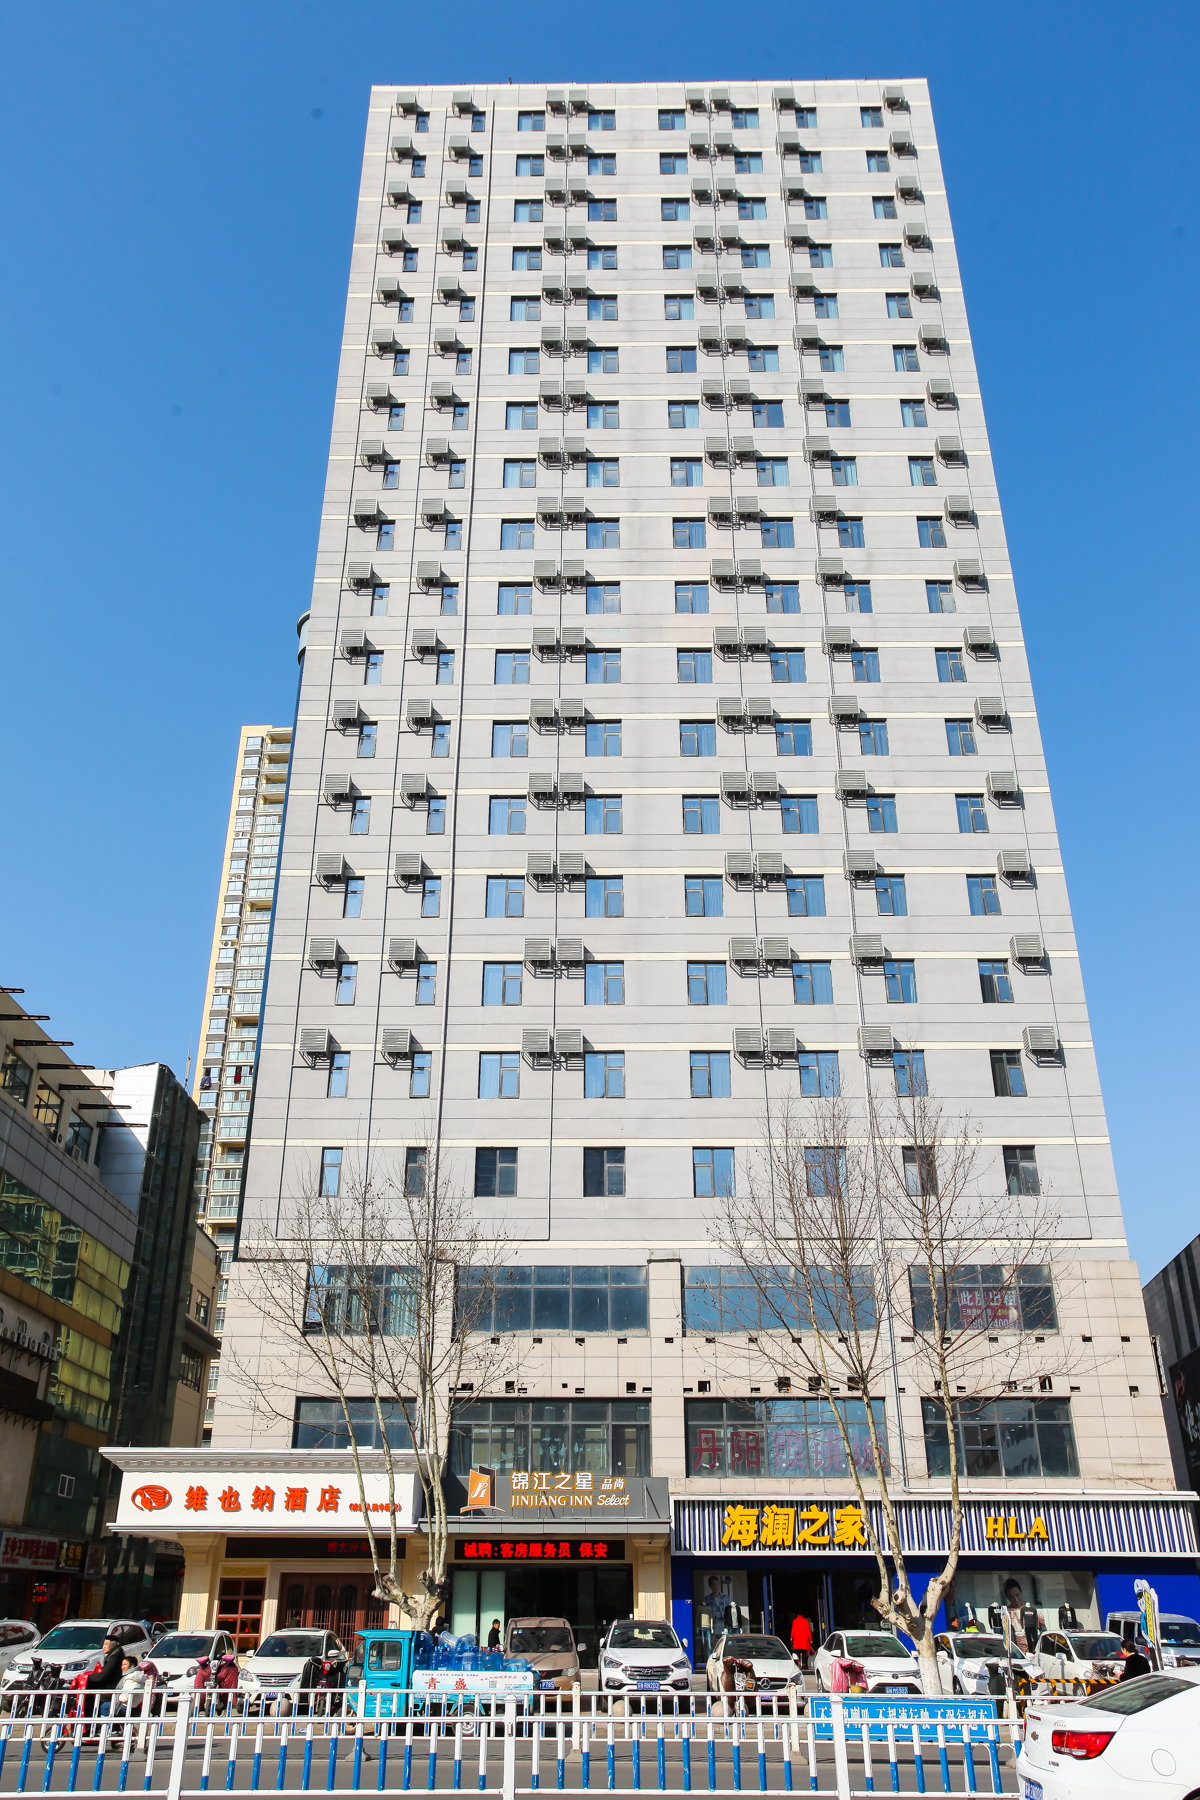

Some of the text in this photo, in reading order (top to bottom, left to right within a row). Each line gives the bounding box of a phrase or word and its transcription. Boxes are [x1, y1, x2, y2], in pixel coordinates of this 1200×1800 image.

[691, 1429, 888, 1471] 丹阳眼镜城
[511, 1470, 626, 1491] 锦江之星 品尚
[184, 1485, 342, 1512] 维也纳酒店
[511, 1493, 631, 1508] JINJIANG INN Select
[722, 1504, 867, 1547] 海澜之家
[986, 1516, 1049, 1539] HLA
[464, 1542, 608, 1558] 诚聘:客房服务员 保安
[817, 1706, 871, 1729] 不鸣喇叭
